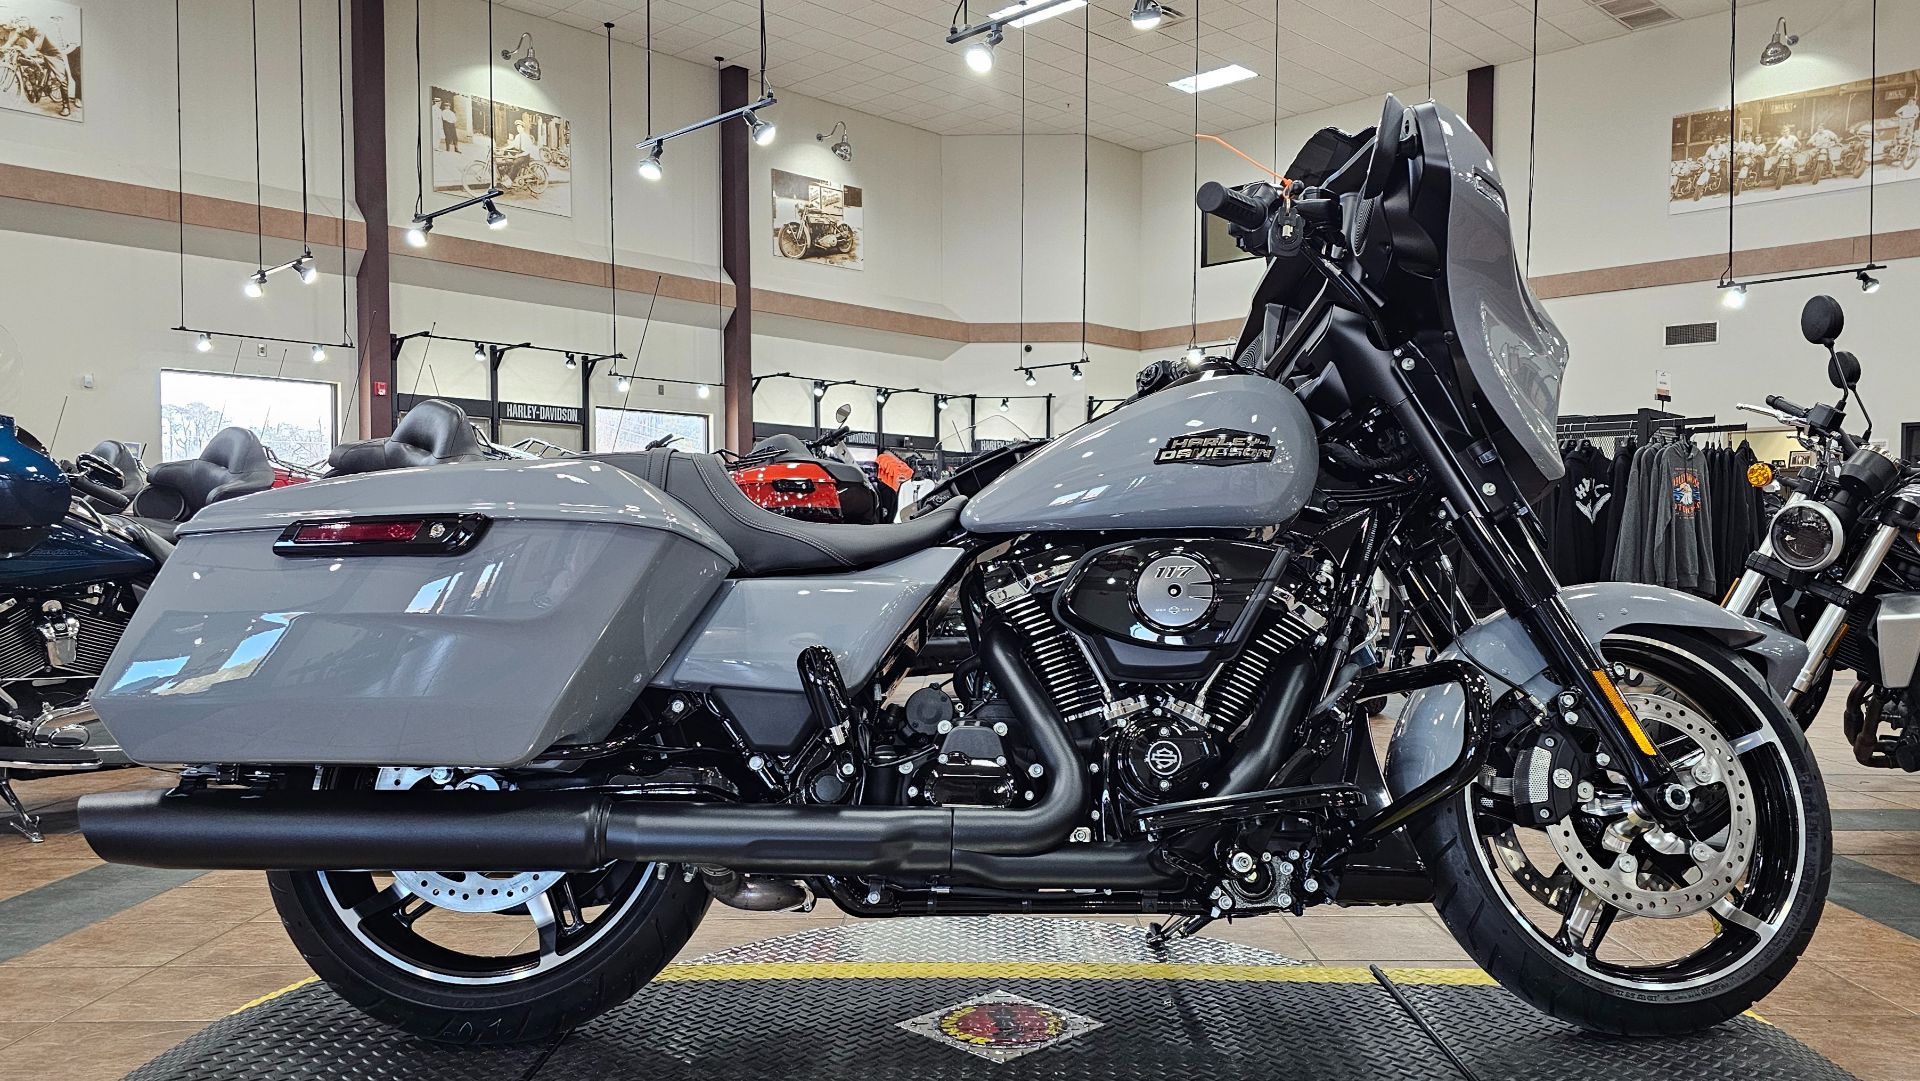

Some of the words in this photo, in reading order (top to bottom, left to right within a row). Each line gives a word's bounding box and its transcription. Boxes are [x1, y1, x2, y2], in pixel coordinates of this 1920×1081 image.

[506, 403, 578, 422] HARLEY-DAVIDSON
[1171, 437, 1266, 448] HARLEY-
[1159, 447, 1272, 460] DAVIDSON
[1154, 565, 1198, 579] 117
